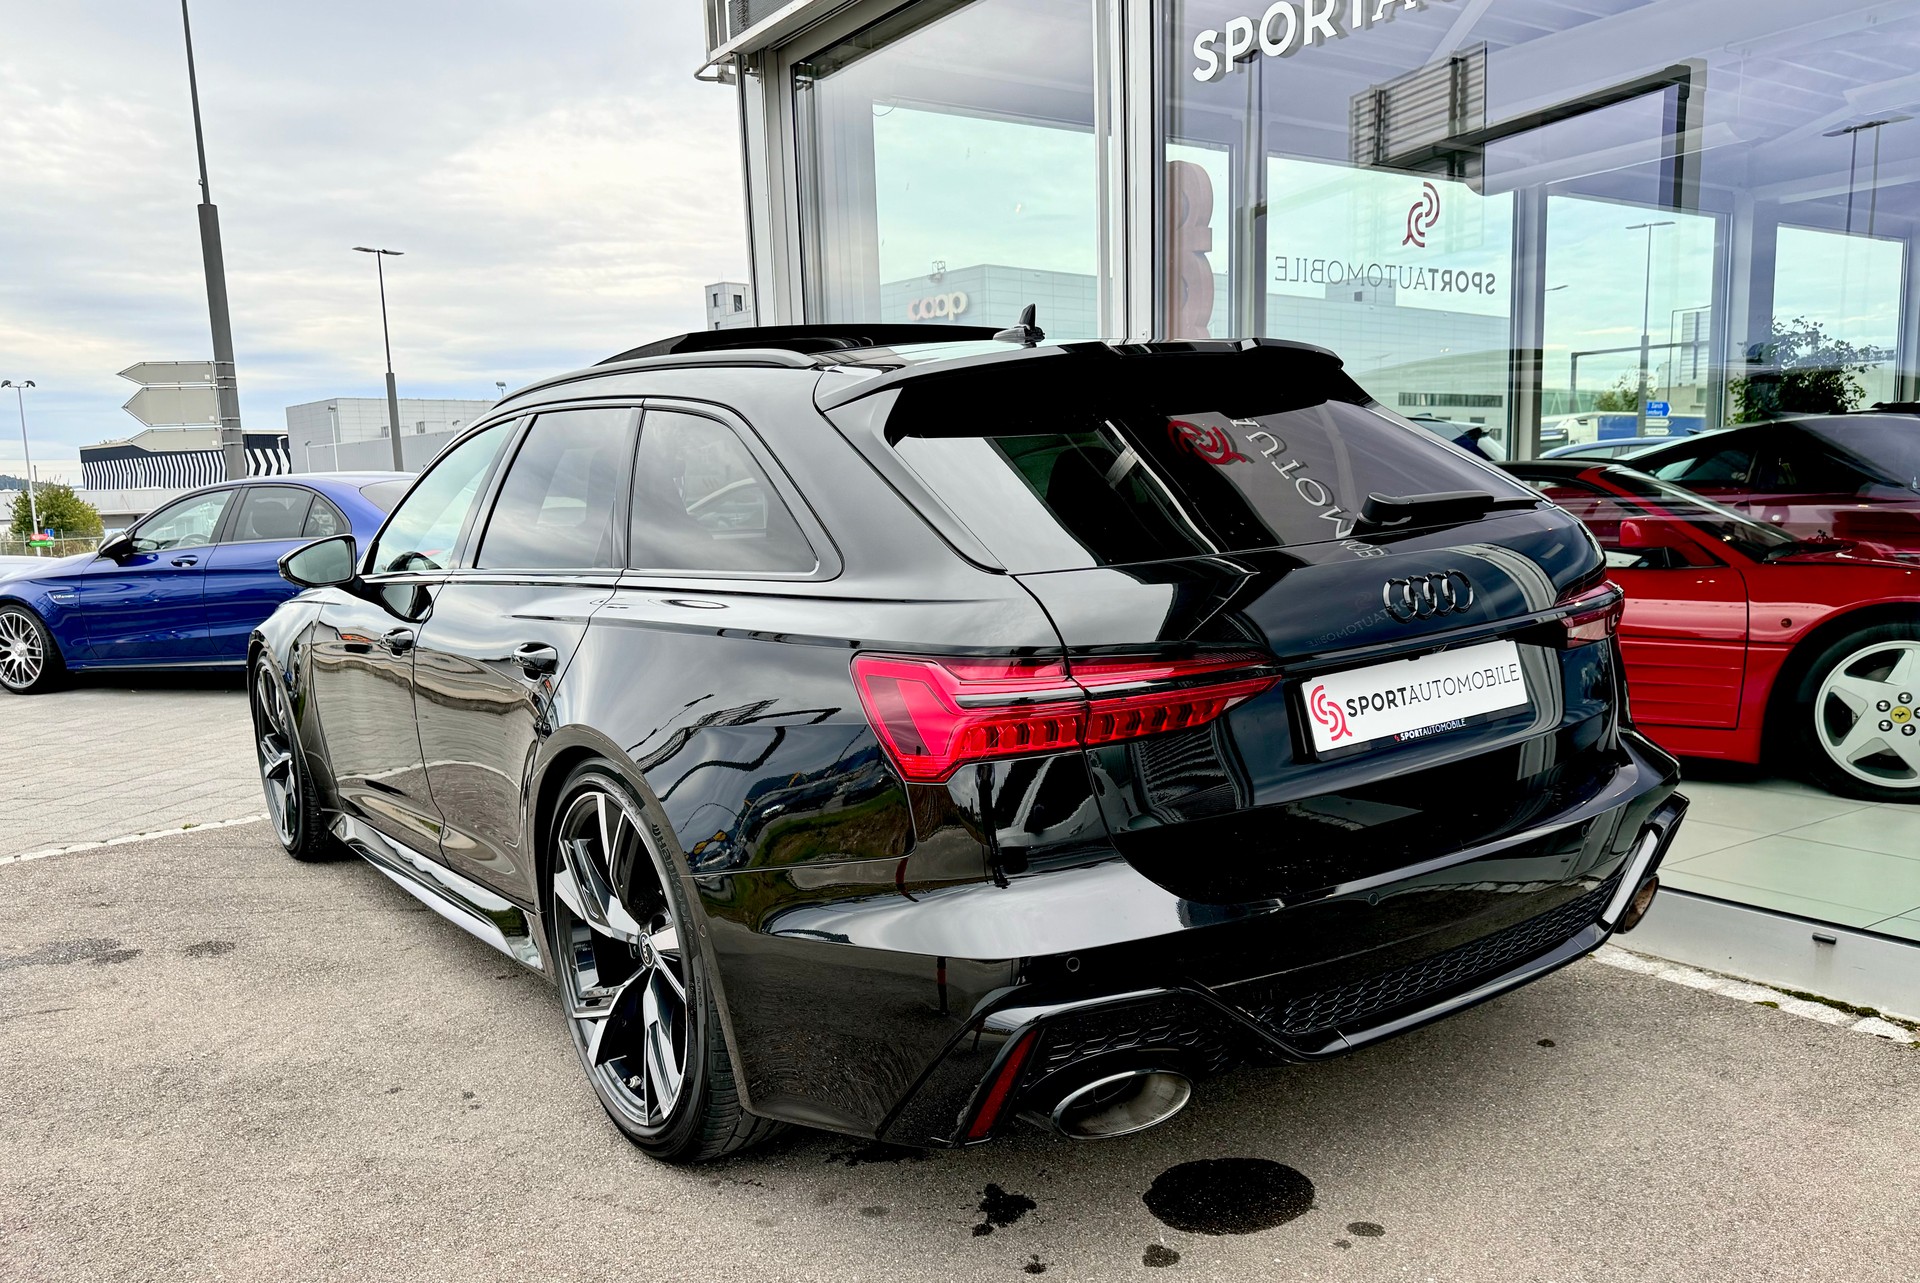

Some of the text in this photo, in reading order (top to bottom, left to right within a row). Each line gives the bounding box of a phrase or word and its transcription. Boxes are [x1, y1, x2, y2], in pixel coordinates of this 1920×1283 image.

[907, 291, 968, 321] coop
[1346, 663, 1520, 718] SPORTAUTOMOBILE
[1400, 718, 1467, 741] SPORTAUTOMOBILE
